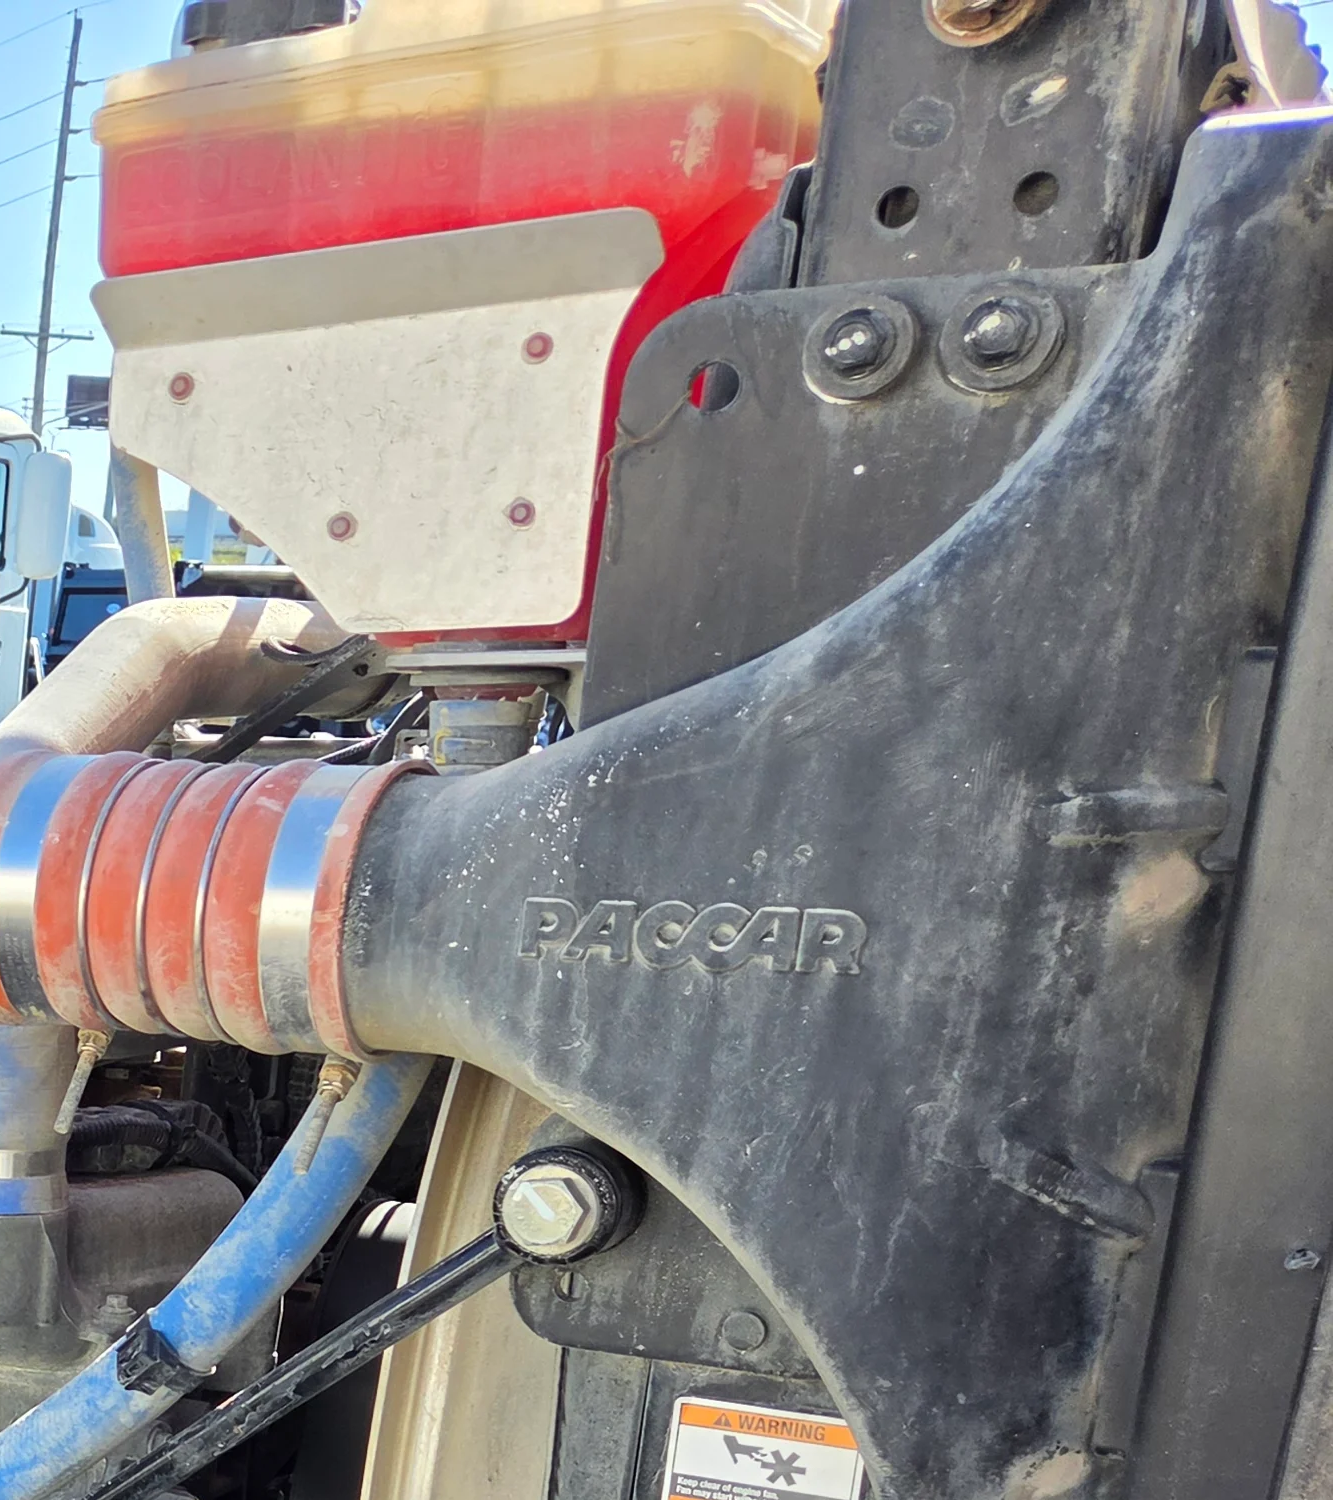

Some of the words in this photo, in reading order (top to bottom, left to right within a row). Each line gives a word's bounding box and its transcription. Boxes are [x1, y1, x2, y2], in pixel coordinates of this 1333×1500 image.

[518, 896, 866, 976] PACCAR
[739, 1414, 825, 1441] WARNING
[676, 1486, 691, 1495] Fan
[693, 1489, 712, 1500] may
[712, 1491, 733, 1500] start
[677, 1477, 698, 1488] Keep
[700, 1480, 721, 1491] clear
[723, 1483, 731, 1492] of
[733, 1486, 761, 1499] engine
[764, 1489, 779, 1500] fan.
